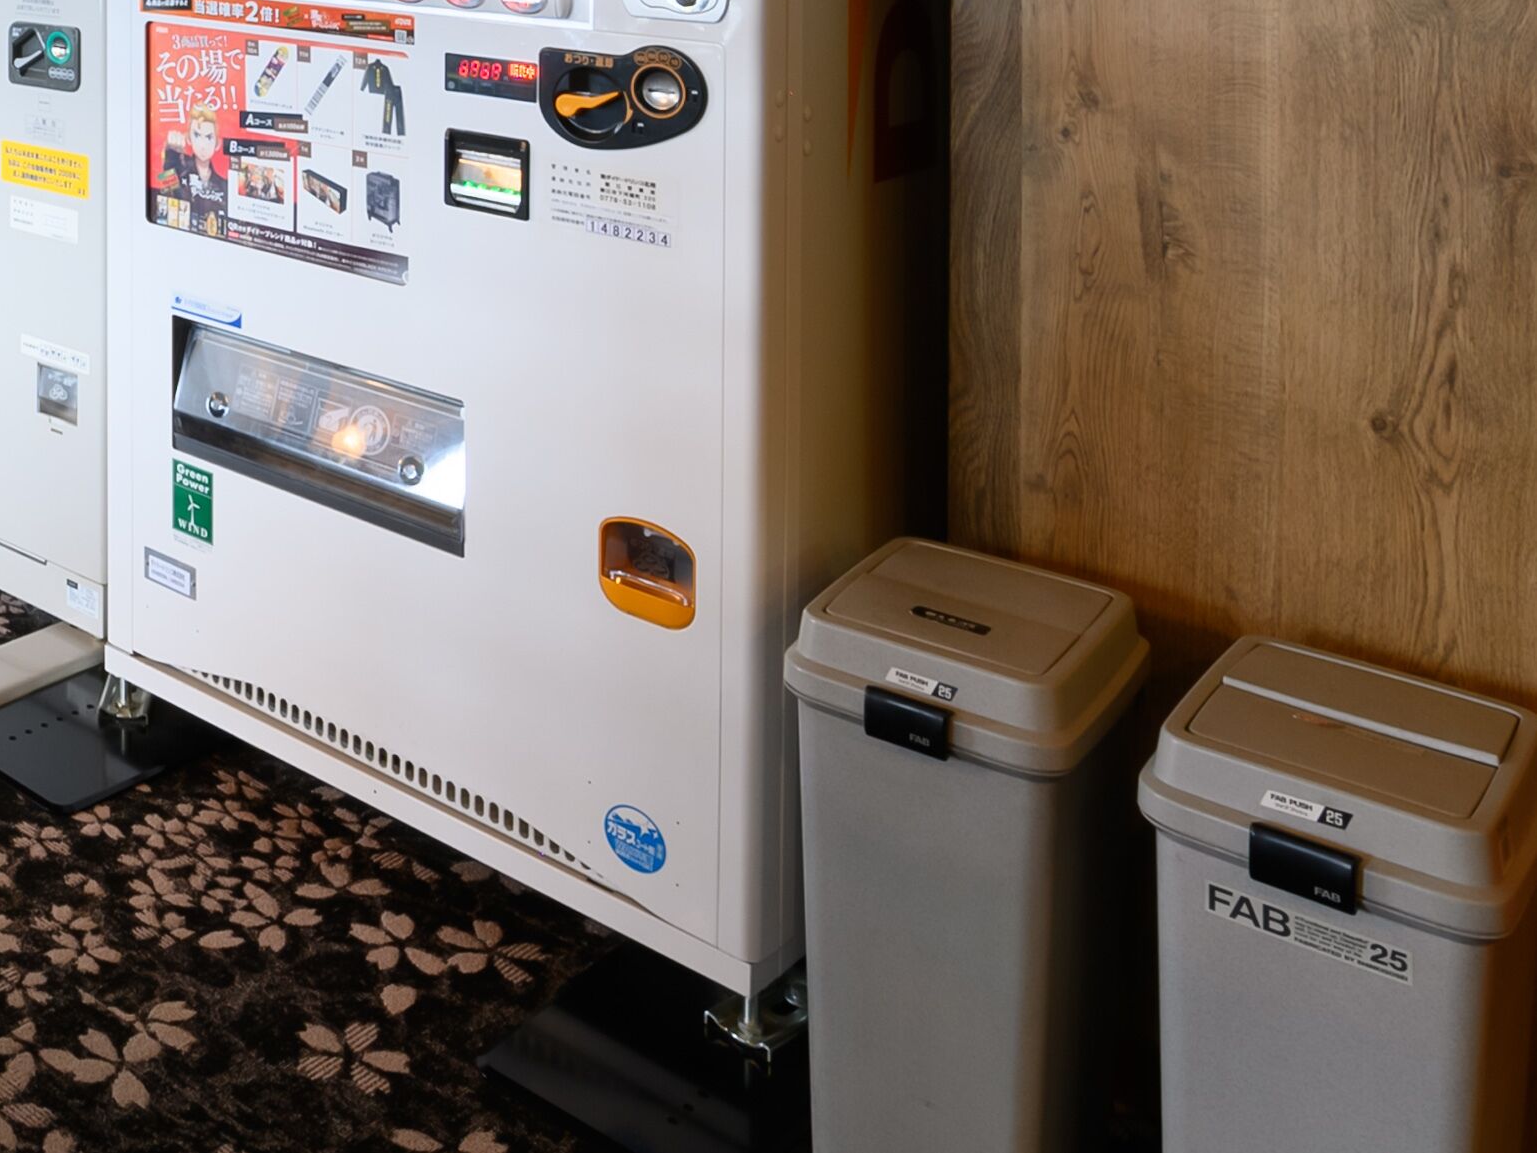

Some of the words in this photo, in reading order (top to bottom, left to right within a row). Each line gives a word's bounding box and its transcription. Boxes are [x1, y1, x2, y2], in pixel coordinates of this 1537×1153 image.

[156, 49, 245, 84] その場で
[157, 86, 239, 125] 当たる!!
[246, 113, 273, 127] Aコース
[229, 141, 255, 155] Bコース
[590, 221, 668, 246] 1482234
[176, 473, 210, 494] Power
[177, 464, 209, 484] Green
[178, 518, 209, 538] WIND
[937, 684, 953, 700] 25
[1289, 799, 1314, 812] PUSH
[1325, 810, 1344, 826] 25
[1314, 886, 1342, 904] FAB
[1208, 883, 1292, 938] FAB
[1369, 943, 1408, 973] 25
